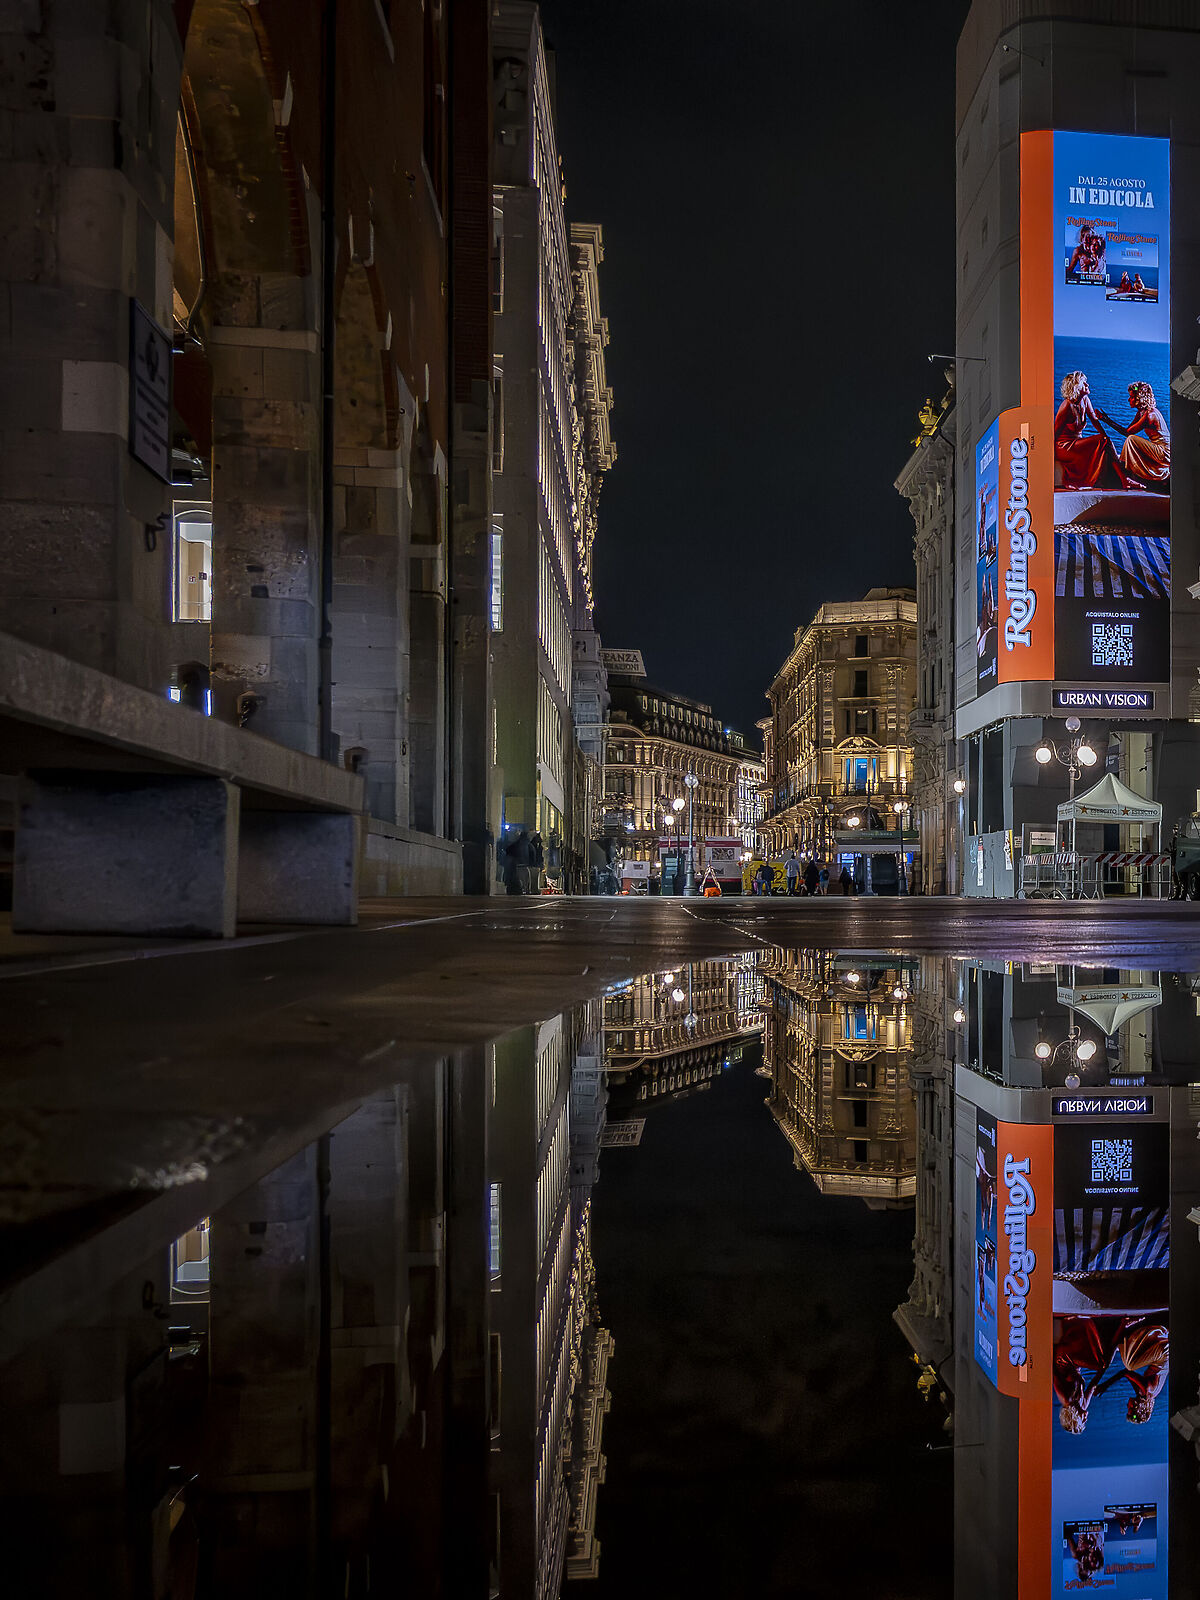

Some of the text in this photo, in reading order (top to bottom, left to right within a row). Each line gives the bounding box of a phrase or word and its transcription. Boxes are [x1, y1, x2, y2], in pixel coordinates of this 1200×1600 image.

[1078, 175, 1146, 189] DAL 25 AGOSTO
[1069, 186, 1155, 209] IN EDICOLA
[1085, 611, 1119, 619] ACQUISTALO
[1059, 692, 1147, 706] URBAN VISION
